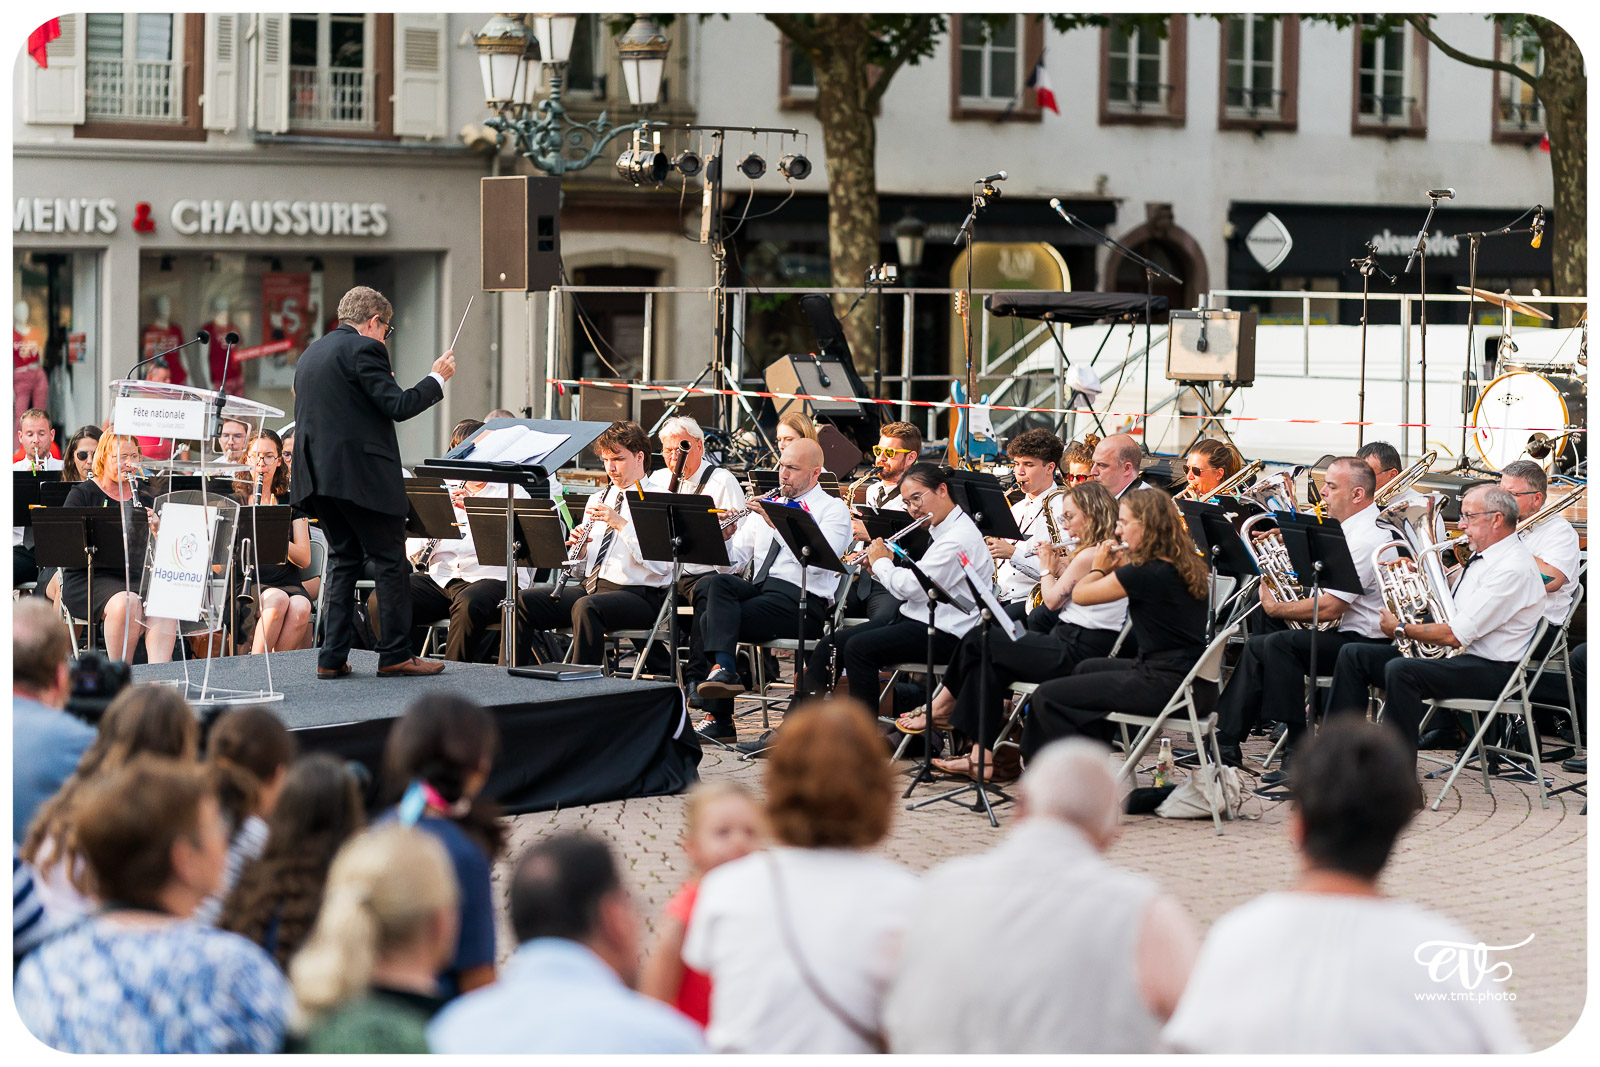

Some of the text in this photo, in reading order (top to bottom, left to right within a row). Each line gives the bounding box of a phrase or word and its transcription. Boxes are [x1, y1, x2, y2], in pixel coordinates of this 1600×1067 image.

[132, 202, 156, 233] &
[171, 198, 389, 236] CHAUSSURES
[133, 407, 185, 420] Fête nationale
[154, 567, 202, 582] Haguenau
